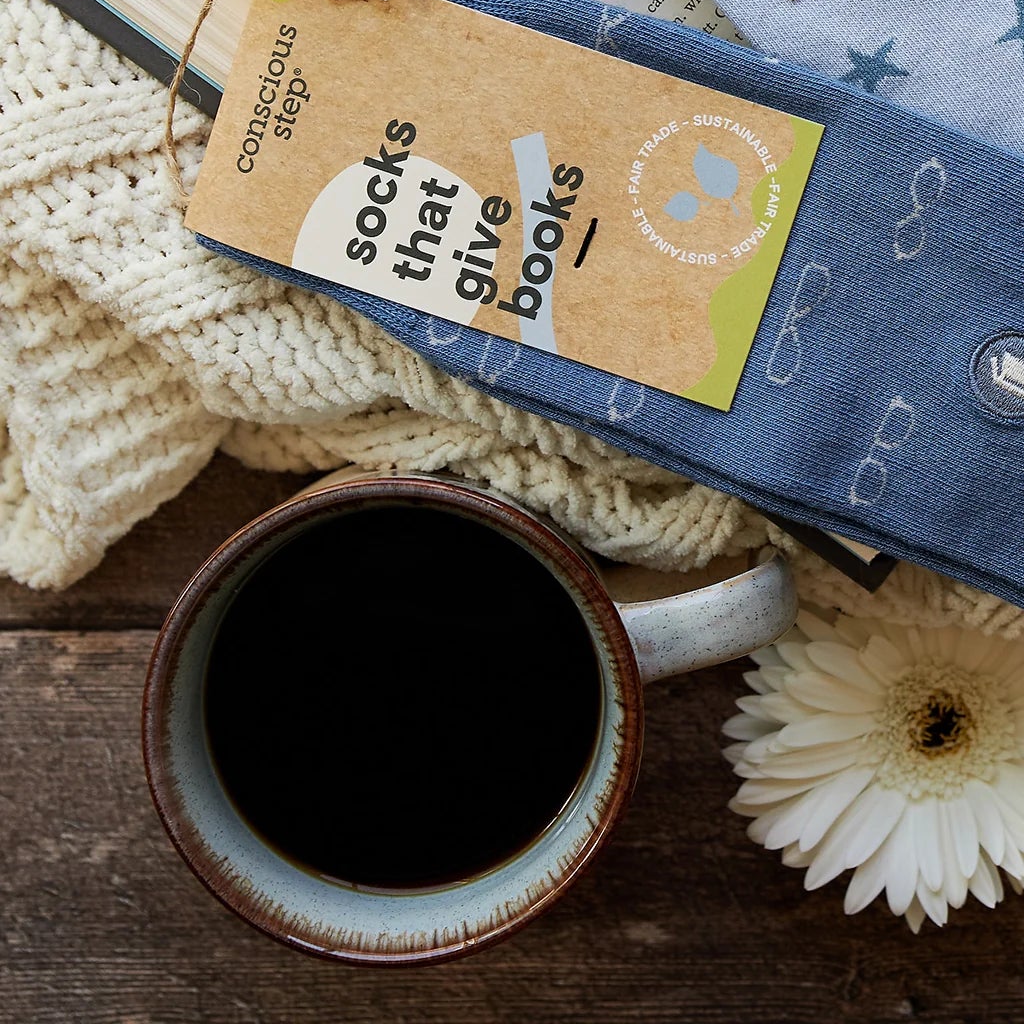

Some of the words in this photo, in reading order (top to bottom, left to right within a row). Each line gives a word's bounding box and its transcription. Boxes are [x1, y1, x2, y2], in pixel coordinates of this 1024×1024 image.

[236, 23, 298, 174] conscious
[638, 120, 680, 158] TRADE
[693, 115, 777, 174] SUSTAINABLE
[346, 118, 418, 265] socks
[629, 160, 645, 195] FAIR
[764, 184, 781, 218] FAIR
[393, 177, 460, 281] that
[454, 194, 512, 305] give
[497, 162, 585, 320] books
[632, 207, 717, 265] SUSTAINABLE
[731, 220, 772, 259] TRADE
